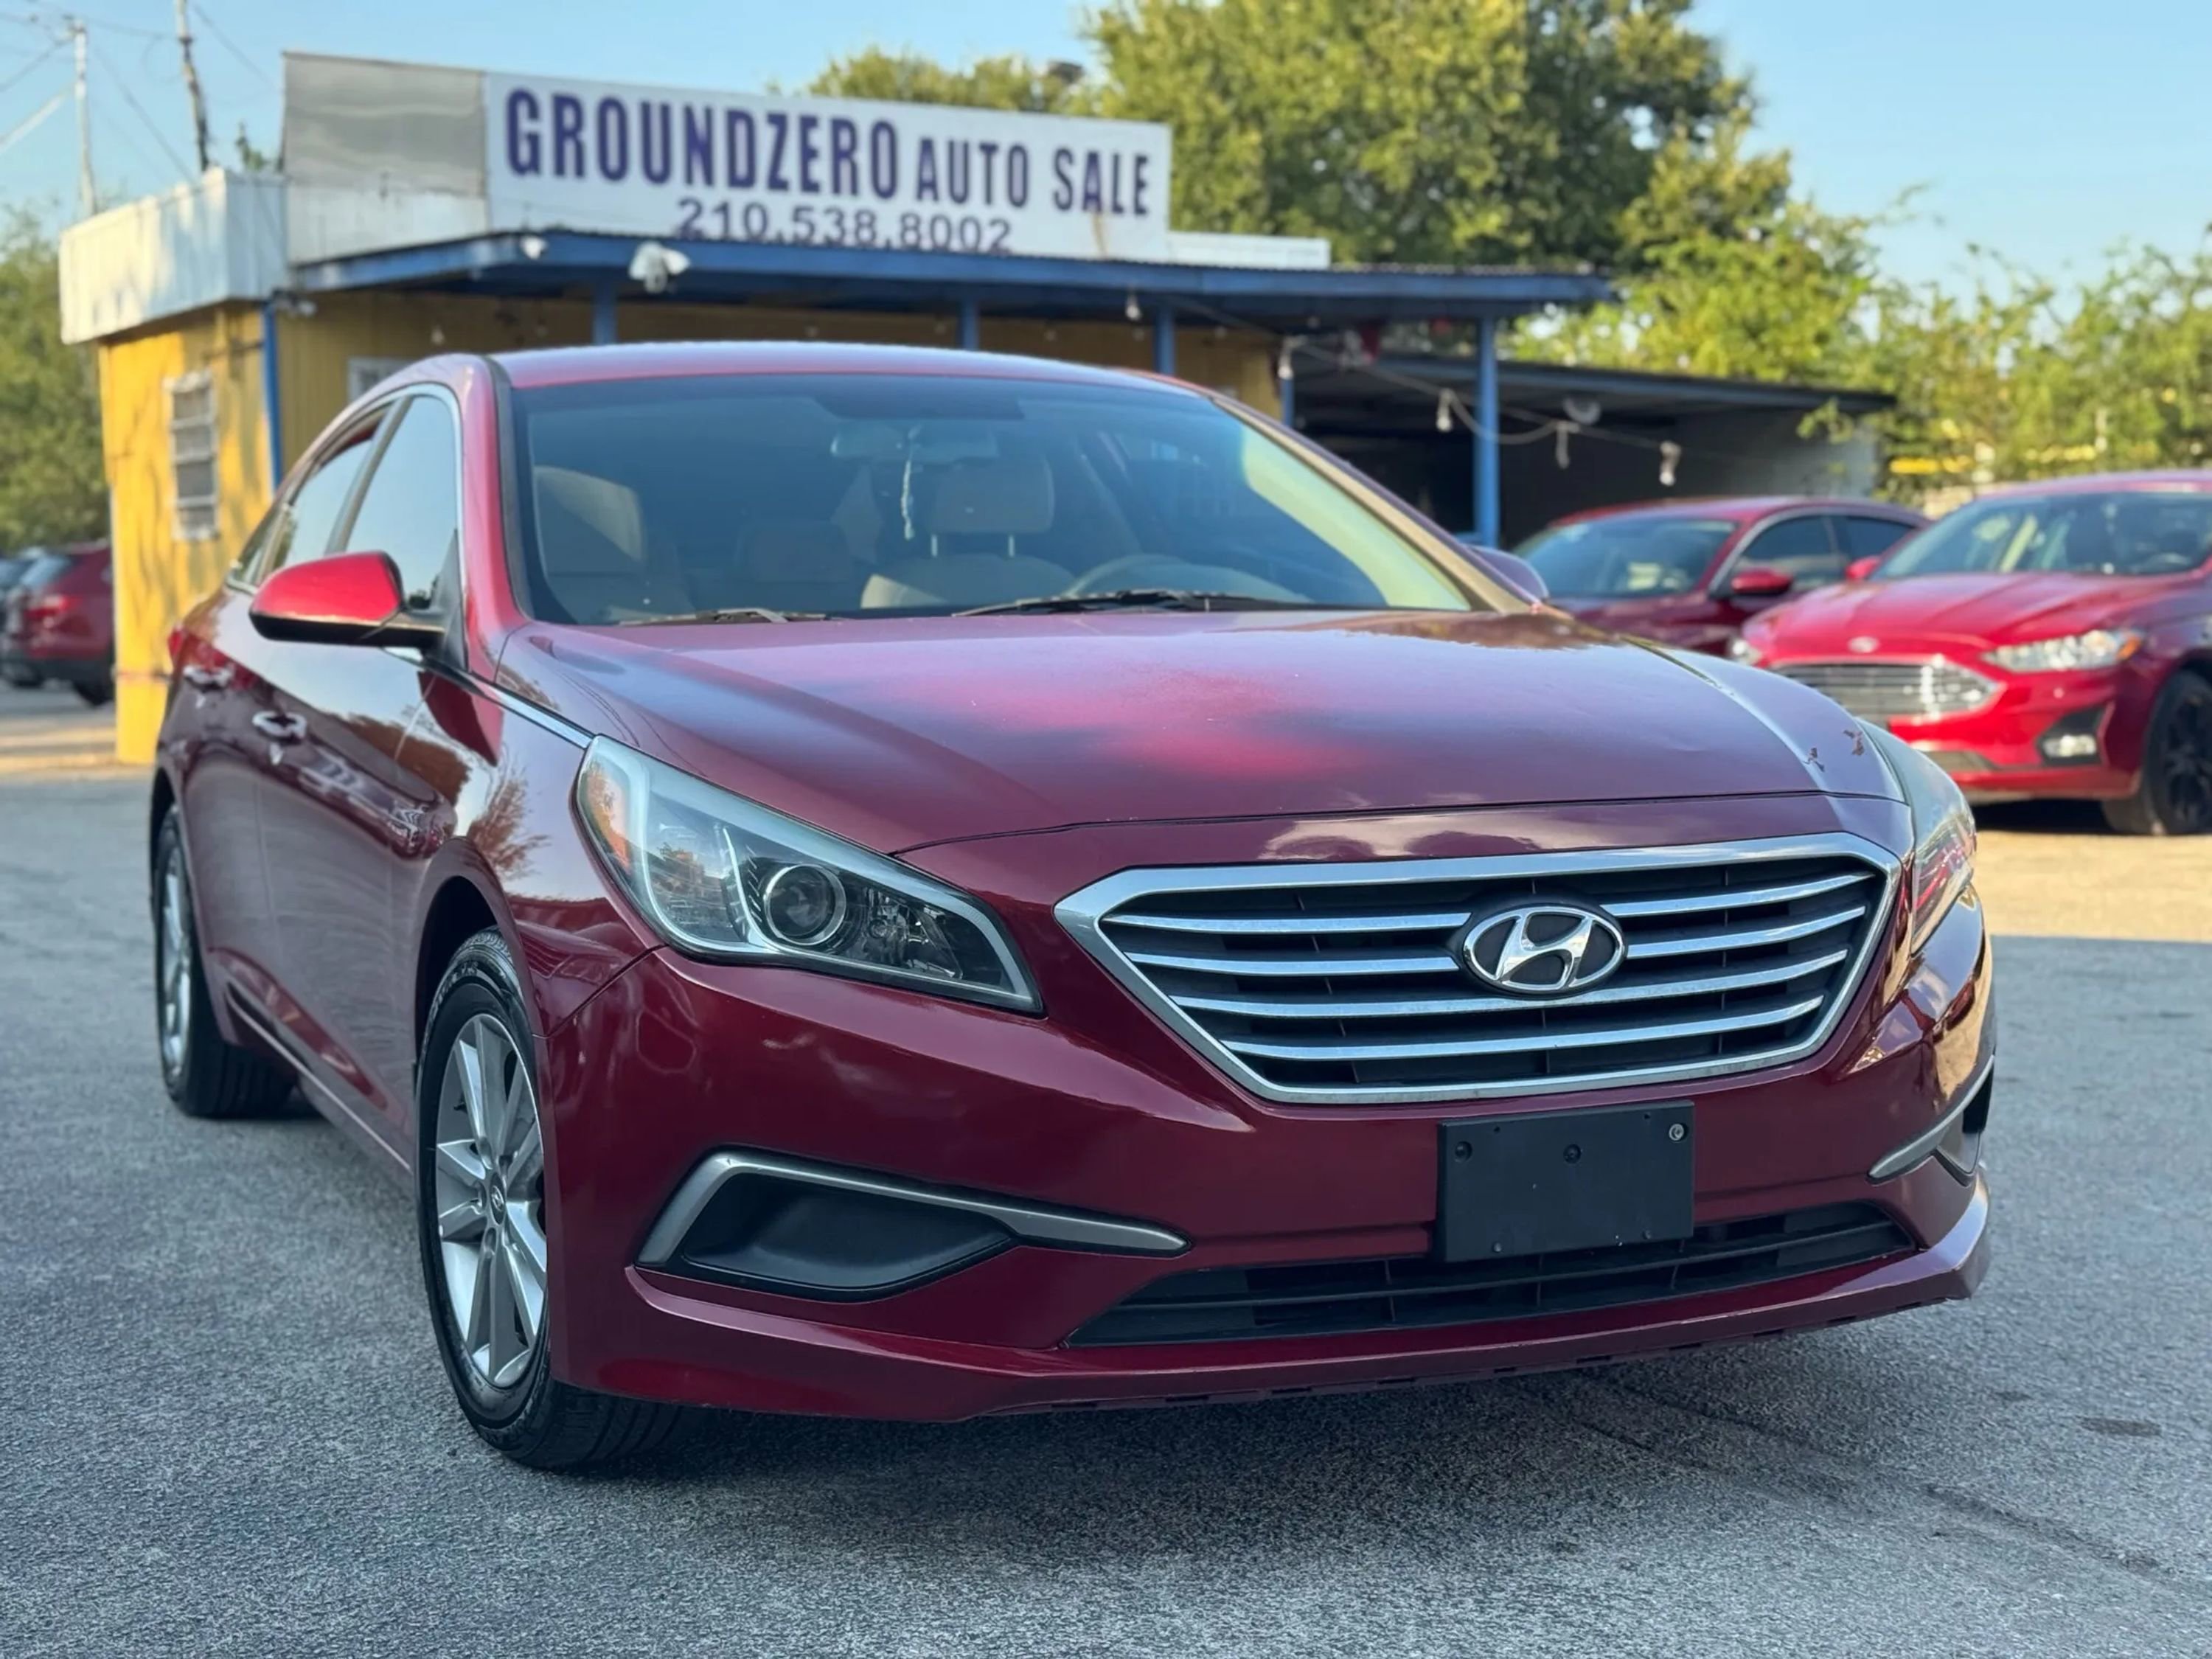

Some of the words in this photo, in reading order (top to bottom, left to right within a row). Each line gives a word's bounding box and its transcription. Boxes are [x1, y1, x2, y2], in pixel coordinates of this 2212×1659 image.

[506, 88, 898, 201] GROUNDZERO
[917, 138, 1029, 208] AUTO
[1053, 148, 1148, 215] SALE
[676, 198, 1012, 254] 210.538.8002
